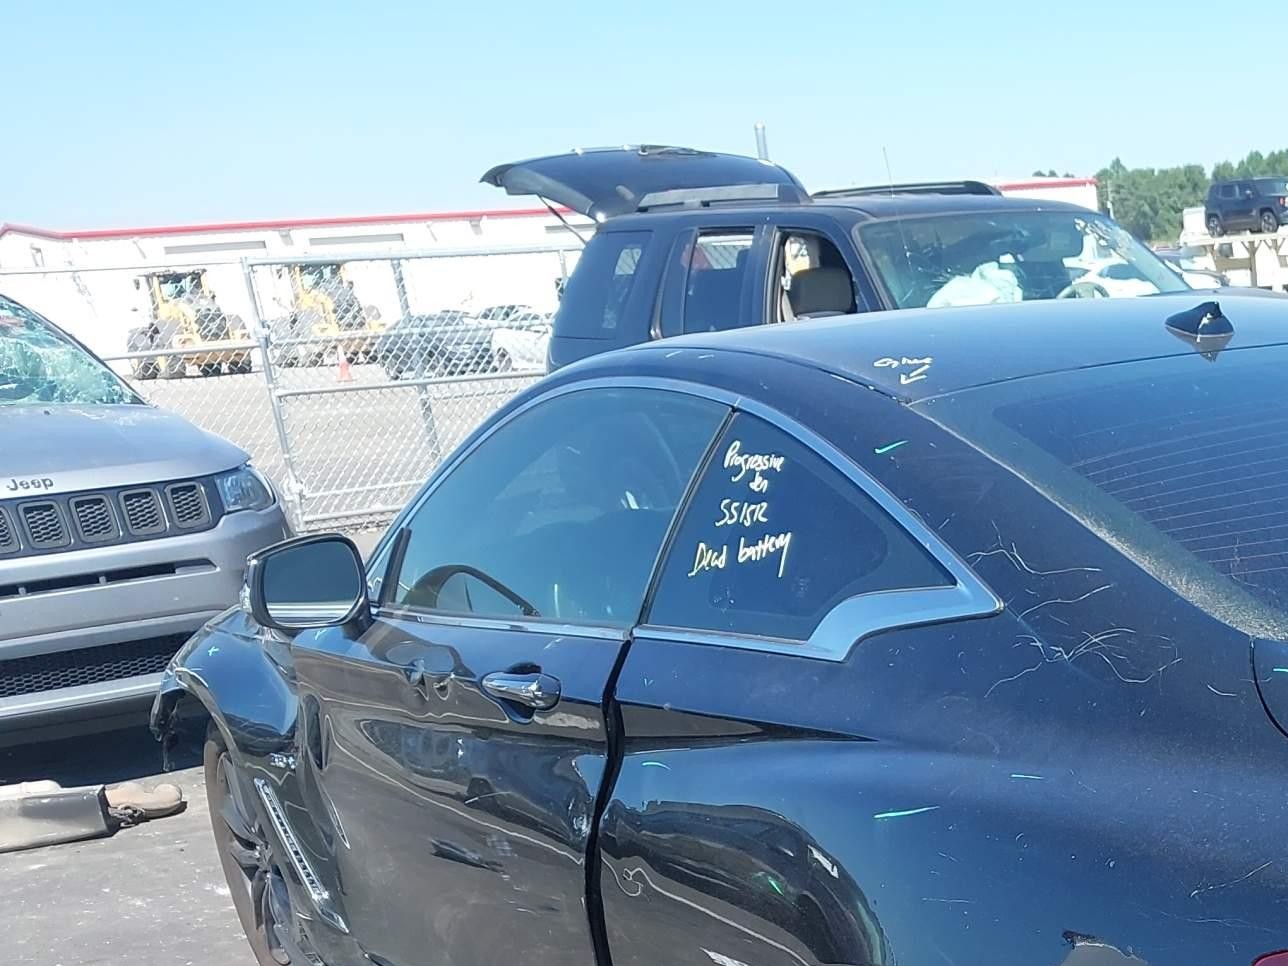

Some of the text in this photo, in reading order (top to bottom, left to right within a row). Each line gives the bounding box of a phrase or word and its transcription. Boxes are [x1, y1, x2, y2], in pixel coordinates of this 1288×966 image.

[724, 440, 785, 482] Progressive
[6, 478, 54, 491] Jeep
[688, 532, 792, 578] Dead battery
